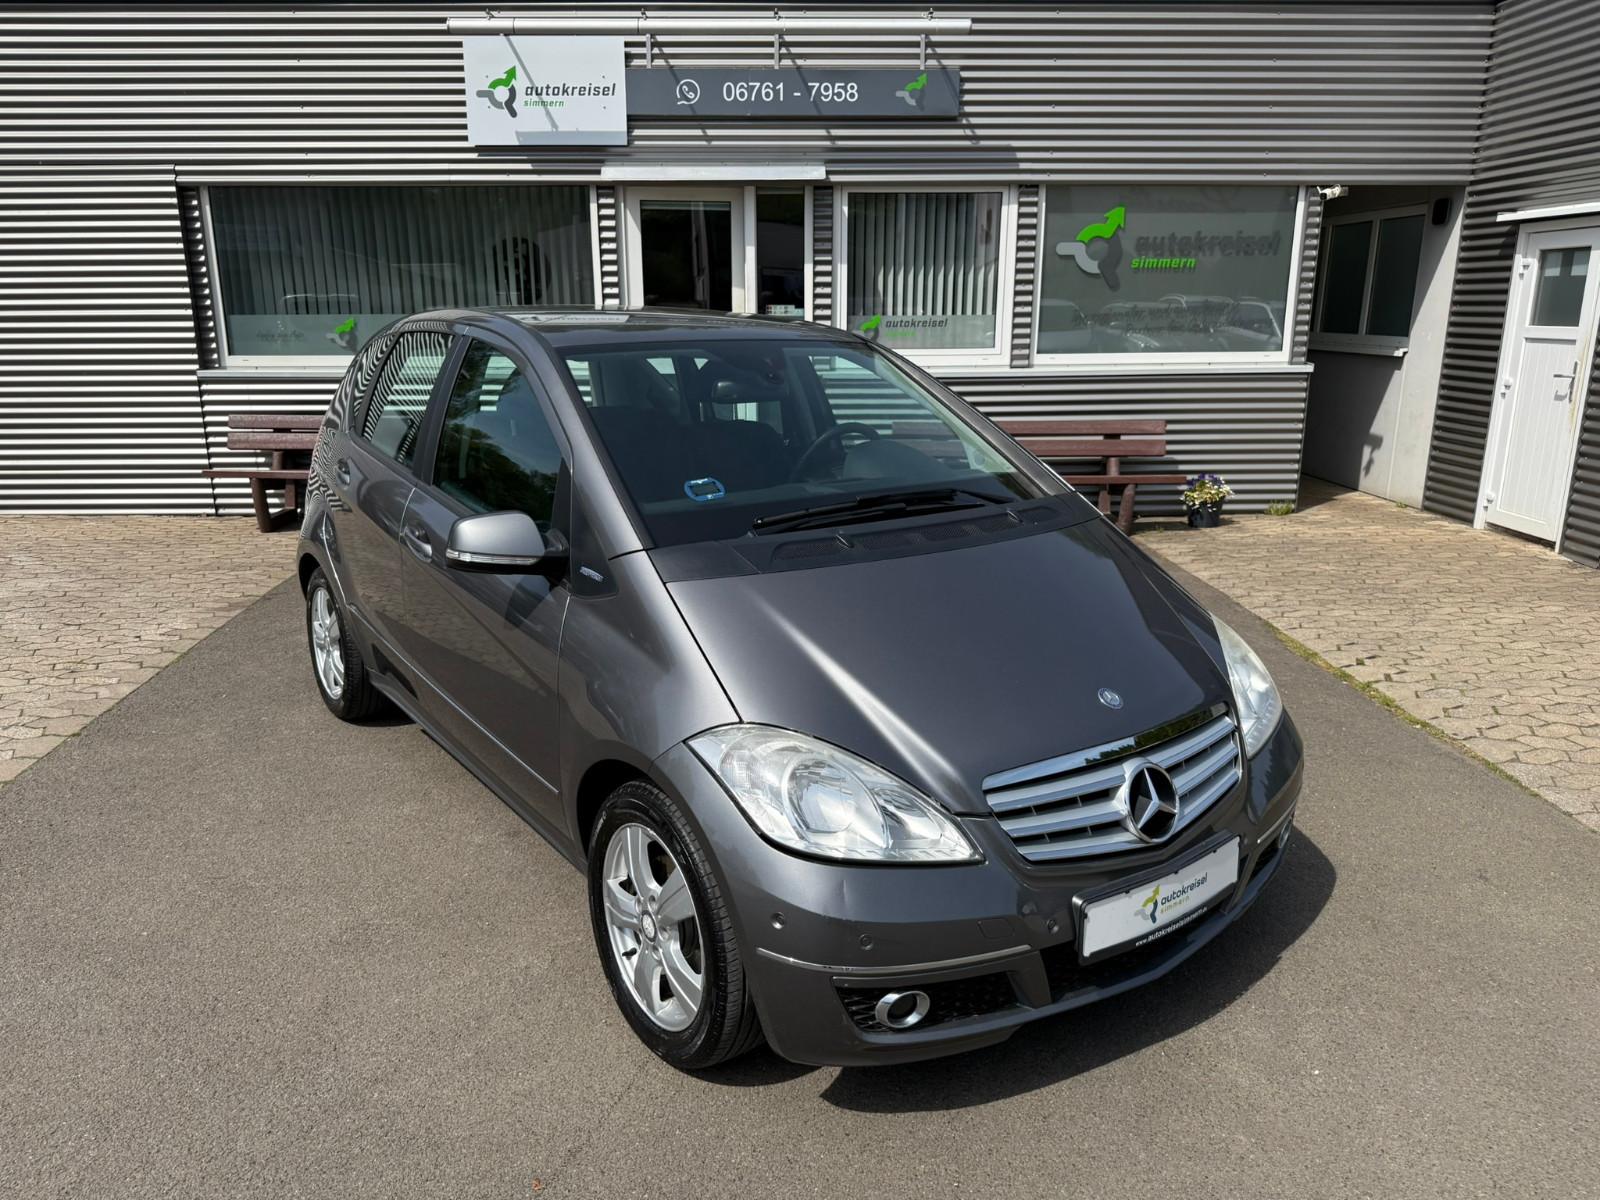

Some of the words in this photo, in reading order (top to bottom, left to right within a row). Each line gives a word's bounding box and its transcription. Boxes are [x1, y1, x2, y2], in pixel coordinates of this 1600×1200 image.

[525, 83, 616, 96] autokreisel
[723, 82, 784, 101] 06761
[807, 82, 859, 101] 7958
[523, 99, 565, 107] simmern
[1135, 230, 1281, 256] autokreisel
[1131, 257, 1197, 269] simmern
[885, 318, 948, 328] autokreisel
[1160, 872, 1208, 906] autokreisel
